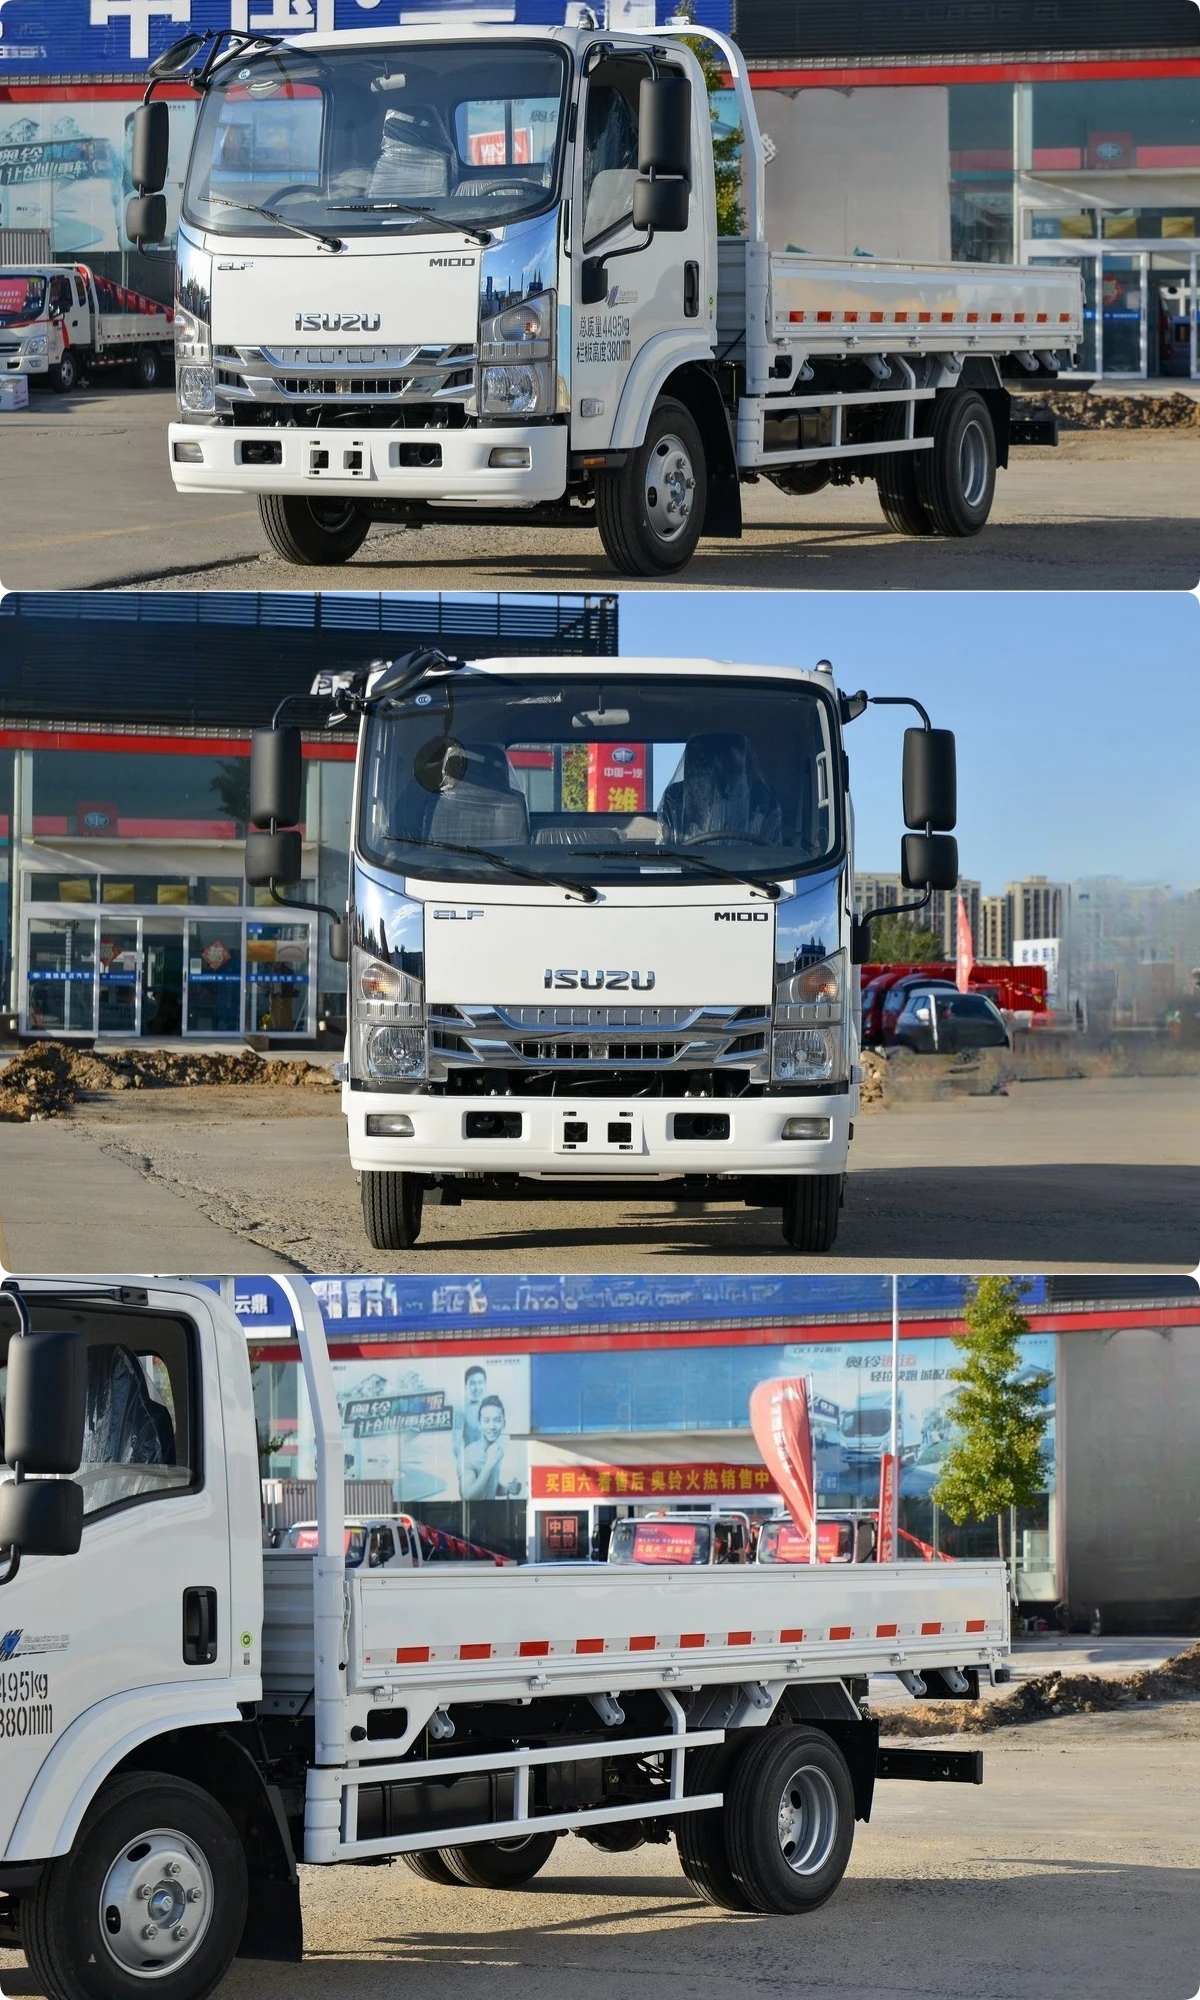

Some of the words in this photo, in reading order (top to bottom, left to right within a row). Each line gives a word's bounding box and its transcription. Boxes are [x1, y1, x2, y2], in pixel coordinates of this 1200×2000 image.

[217, 261, 254, 271] ELF
[294, 312, 381, 332] ISUZU
[580, 315, 630, 338] 总质量4495kg
[603, 767, 643, 779] 中国一汽
[432, 909, 485, 920] ELF
[543, 968, 655, 991] ISUZU
[235, 1293, 268, 1315] 云鼎
[545, 1472, 592, 1493] 买国六
[598, 1471, 645, 1492] 看售后
[651, 1467, 770, 1491] 奥铃火热销售中
[549, 1519, 575, 1533] 中国
